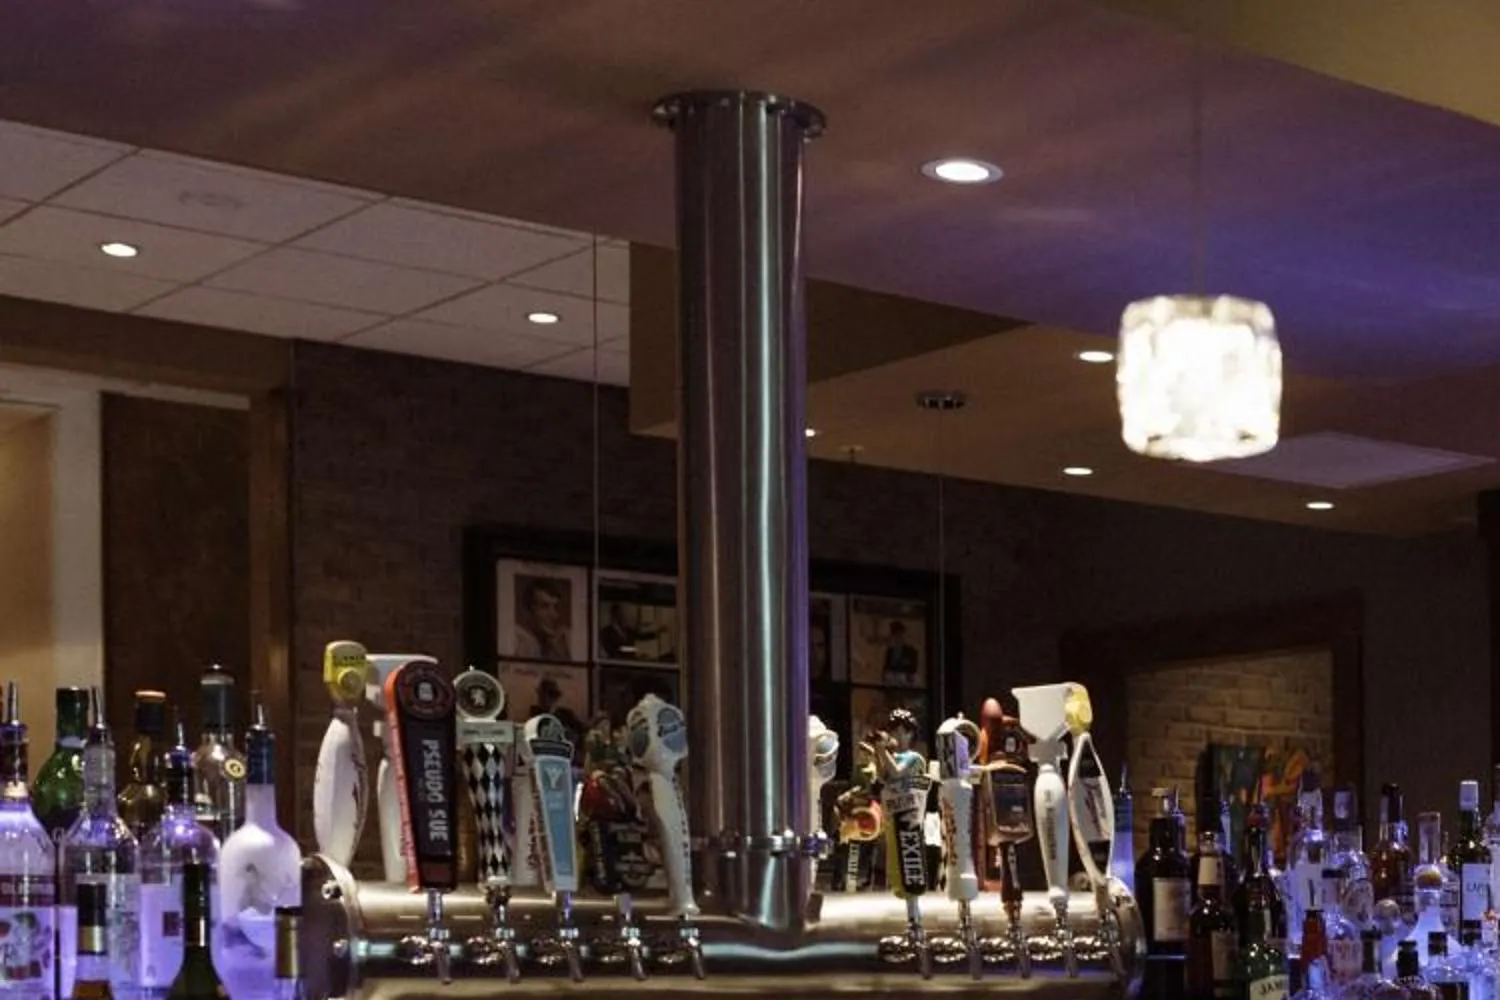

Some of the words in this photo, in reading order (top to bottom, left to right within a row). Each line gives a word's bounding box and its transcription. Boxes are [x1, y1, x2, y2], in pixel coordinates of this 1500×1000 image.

[421, 740, 444, 803] PSEUDO
[428, 808, 449, 841] SUE
[900, 831, 925, 886] EXILE
